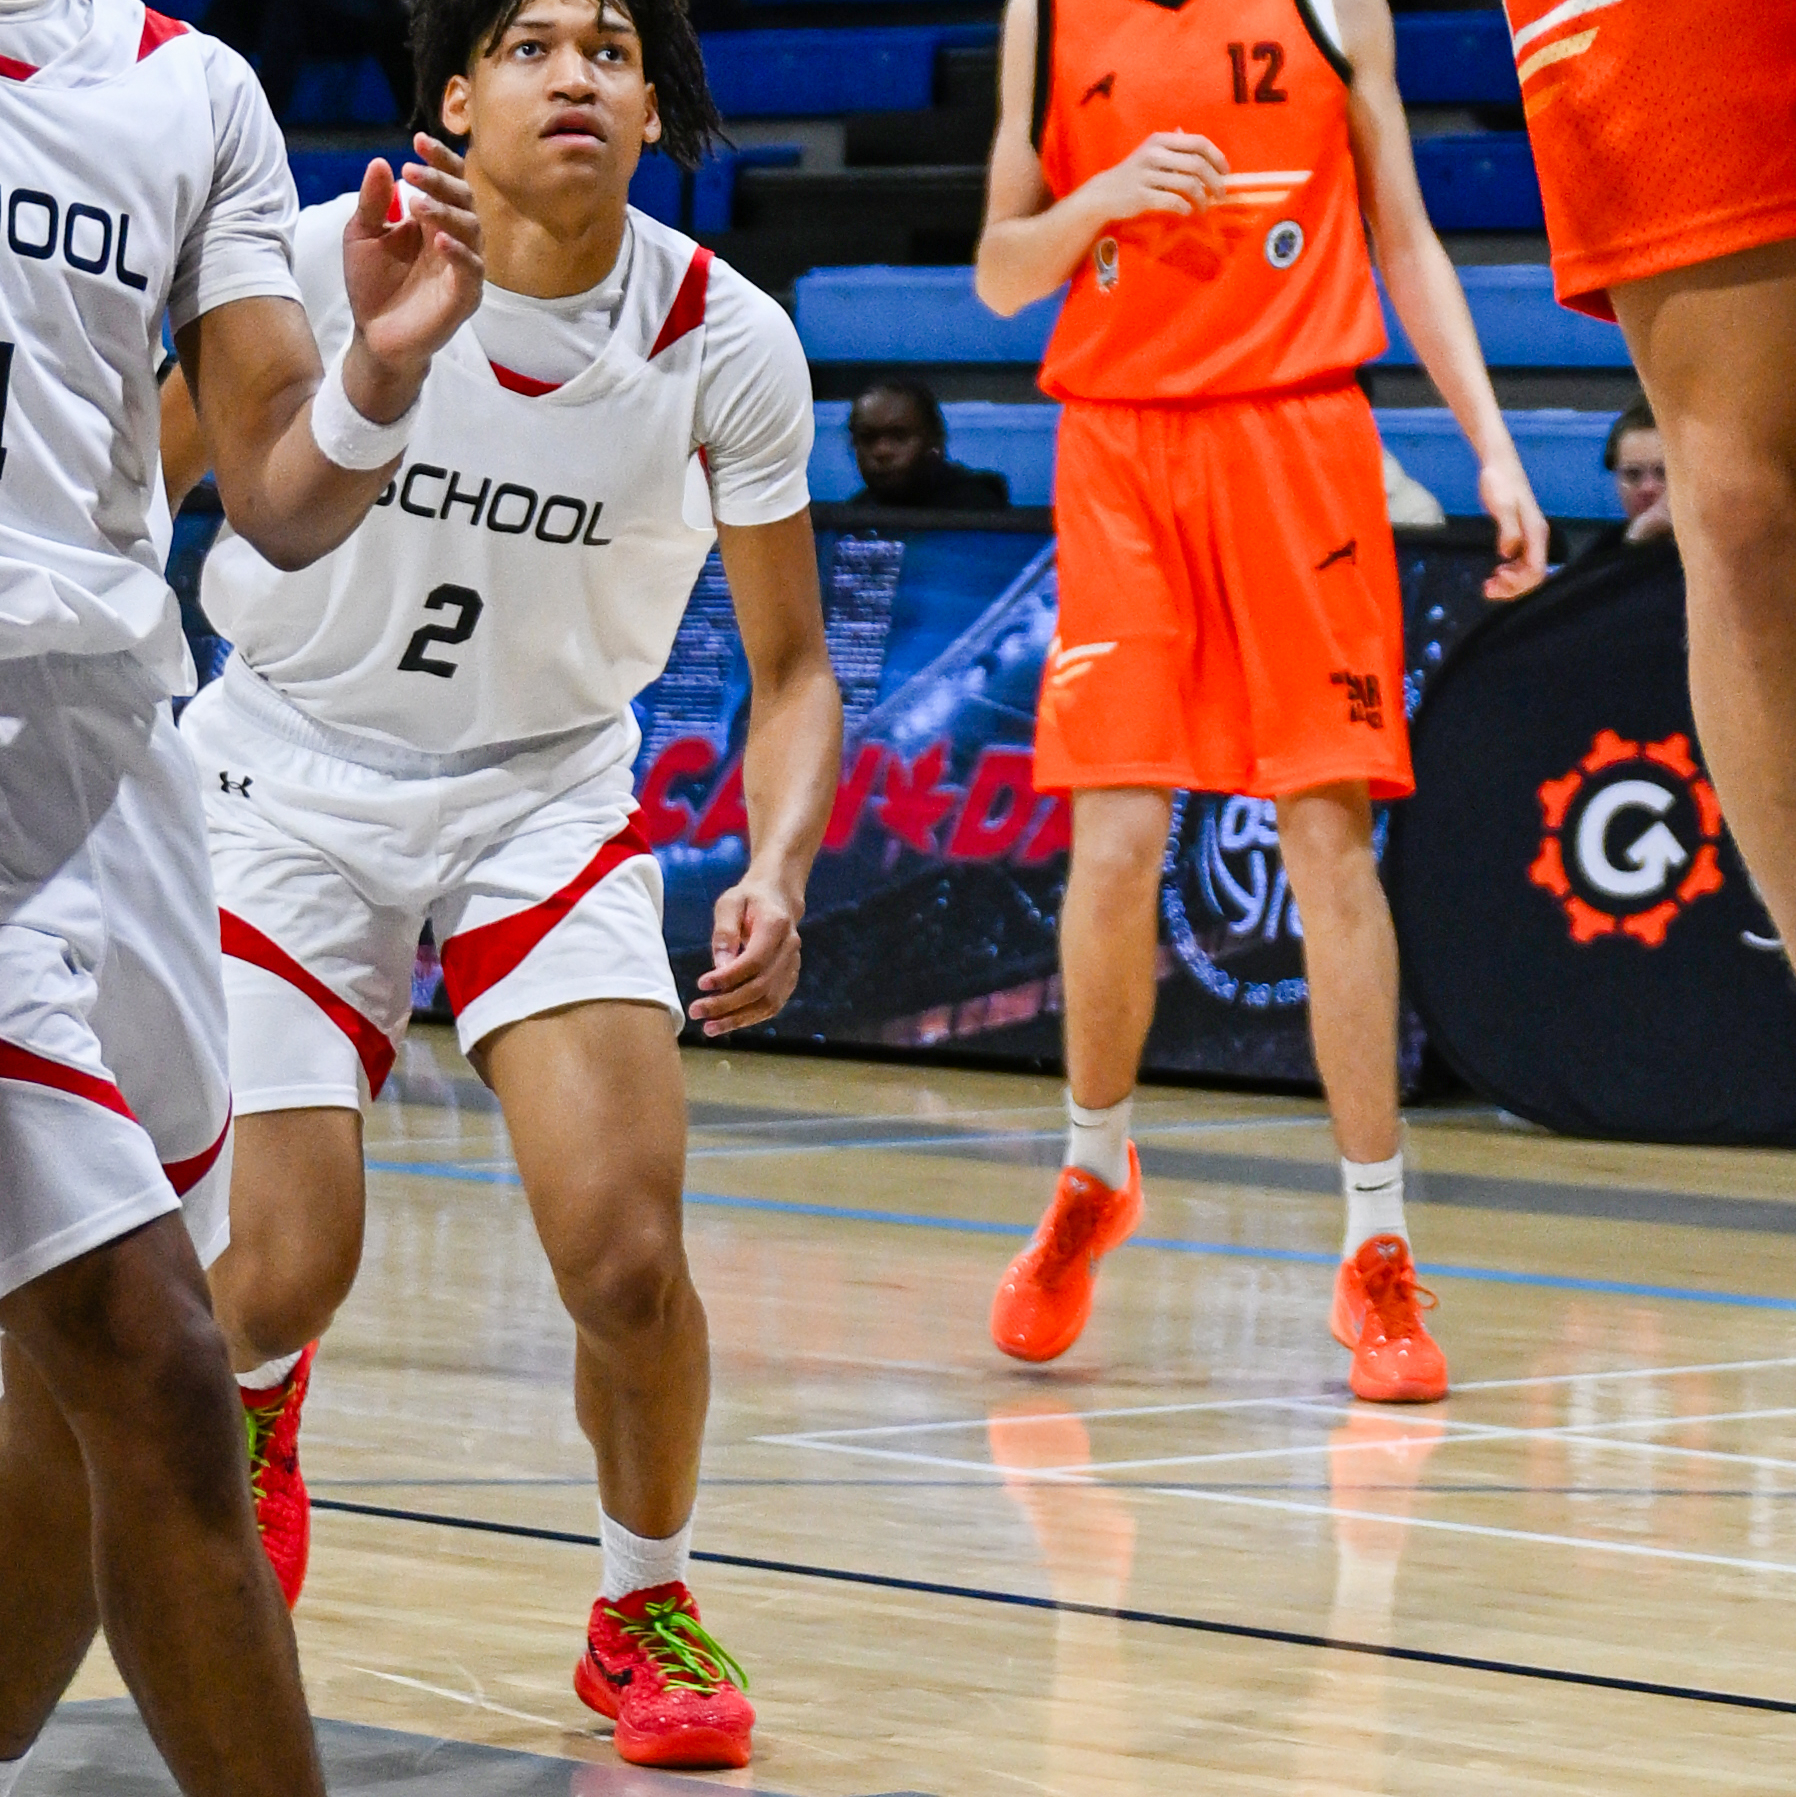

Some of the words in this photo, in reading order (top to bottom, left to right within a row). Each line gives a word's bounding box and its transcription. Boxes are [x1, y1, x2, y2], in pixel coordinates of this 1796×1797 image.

[1226, 41, 1288, 105] 12
[0, 184, 148, 292] OOL
[397, 582, 484, 679] 2
